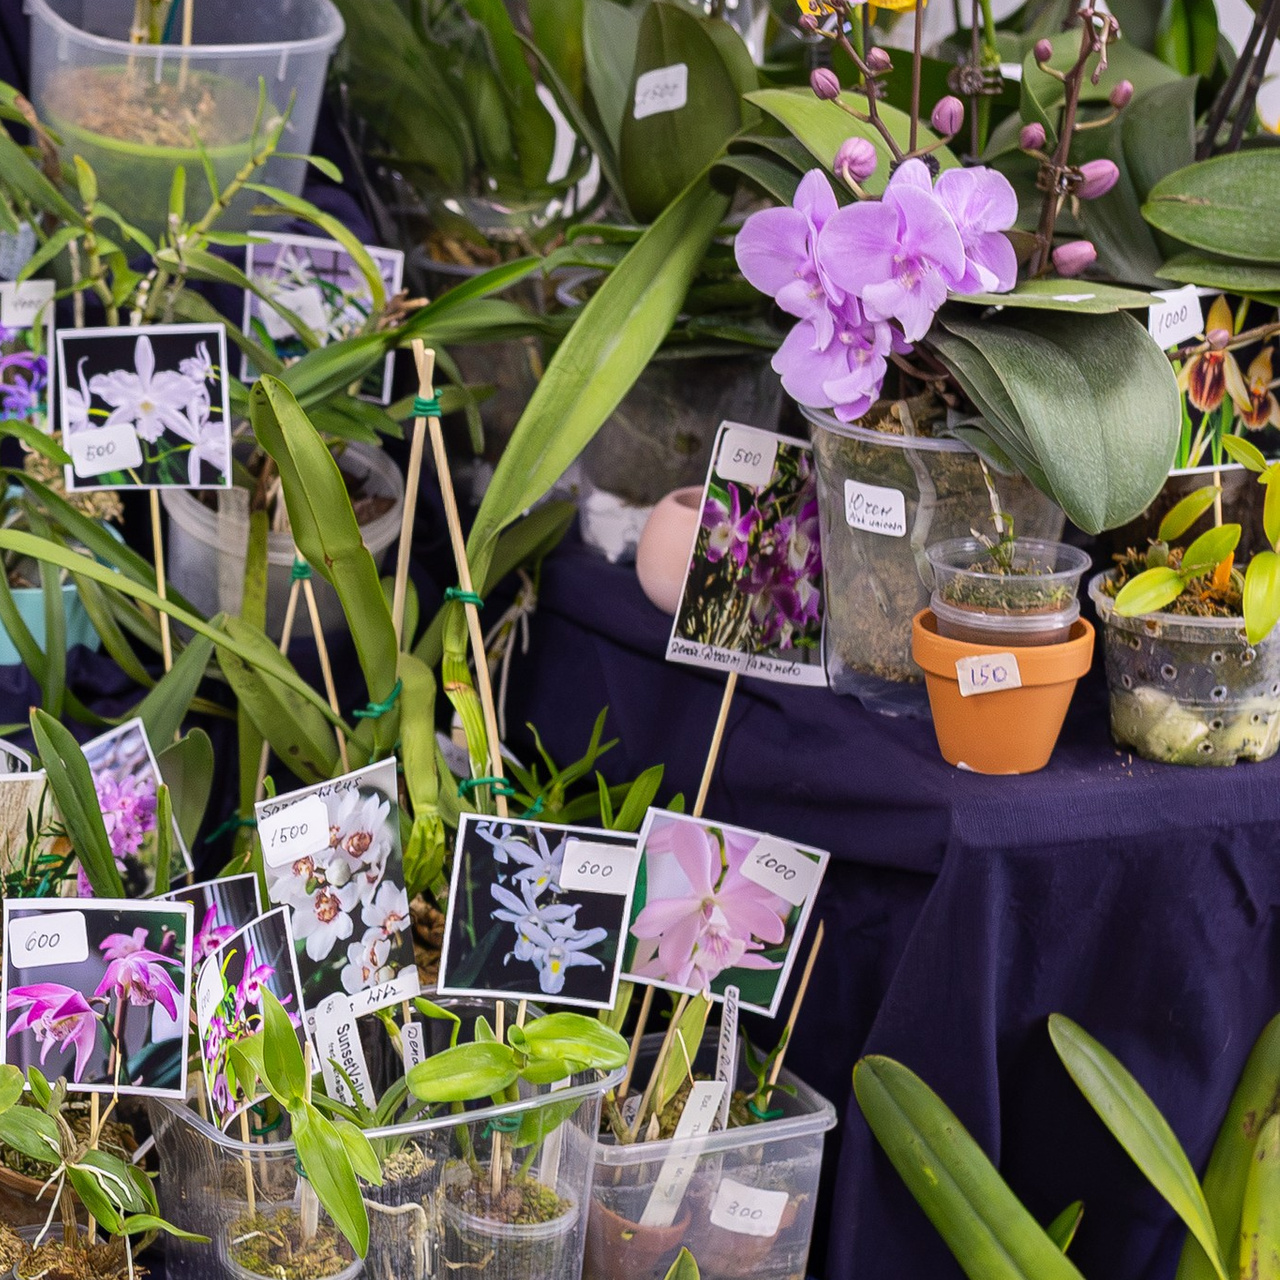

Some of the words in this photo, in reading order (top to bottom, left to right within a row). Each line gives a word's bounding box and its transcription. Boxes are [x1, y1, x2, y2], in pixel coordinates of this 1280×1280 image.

[1159, 305, 1188, 333] 1000
[86, 441, 116, 462] 500
[732, 448, 763, 467] 500
[970, 663, 1008, 687] 150
[271, 823, 309, 847] 1500
[577, 860, 613, 878] 500
[756, 852, 797, 881] 1000
[24, 930, 61, 952] 600
[726, 1200, 763, 1220] 300
